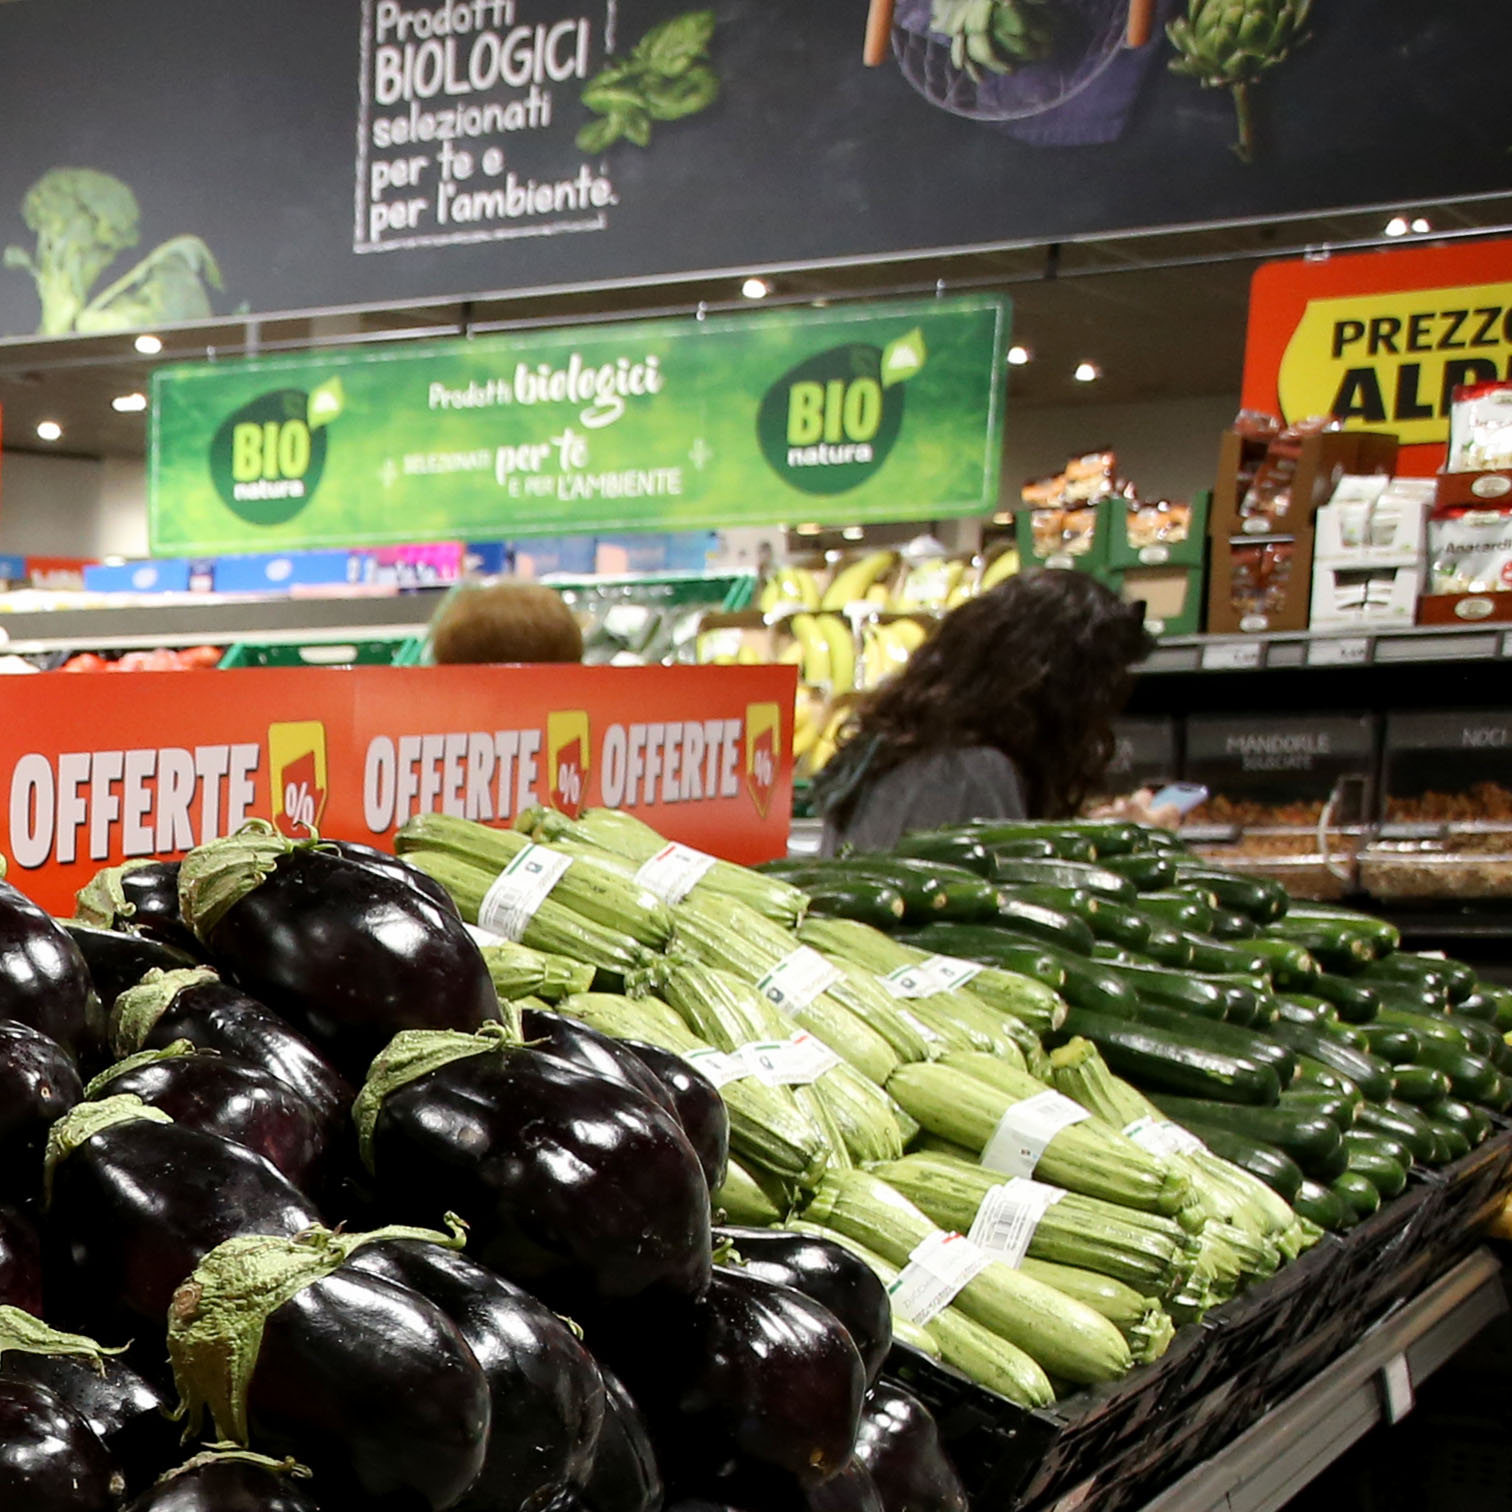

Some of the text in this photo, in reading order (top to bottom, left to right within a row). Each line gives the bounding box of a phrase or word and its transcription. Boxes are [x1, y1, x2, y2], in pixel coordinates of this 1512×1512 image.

[376, 0, 516, 43] Prodotti
[376, 17, 589, 105] BIOLOGICI
[373, 85, 552, 148] selezionati
[371, 139, 504, 202] per te e
[370, 164, 619, 243] per l'ambiente.
[429, 352, 663, 428] Prodotti biologici
[787, 377, 882, 446] BIO
[1330, 357, 1512, 423] ALD
[233, 419, 311, 482] BIO
[495, 443, 551, 486] per
[549, 428, 589, 472] te
[787, 442, 873, 467] natura
[233, 479, 304, 501] natura
[557, 467, 682, 500] L'AMBIENTE
[364, 729, 542, 833] OFFERTE
[602, 718, 743, 808] OFFERTE
[9, 743, 260, 868] OFFERTE
